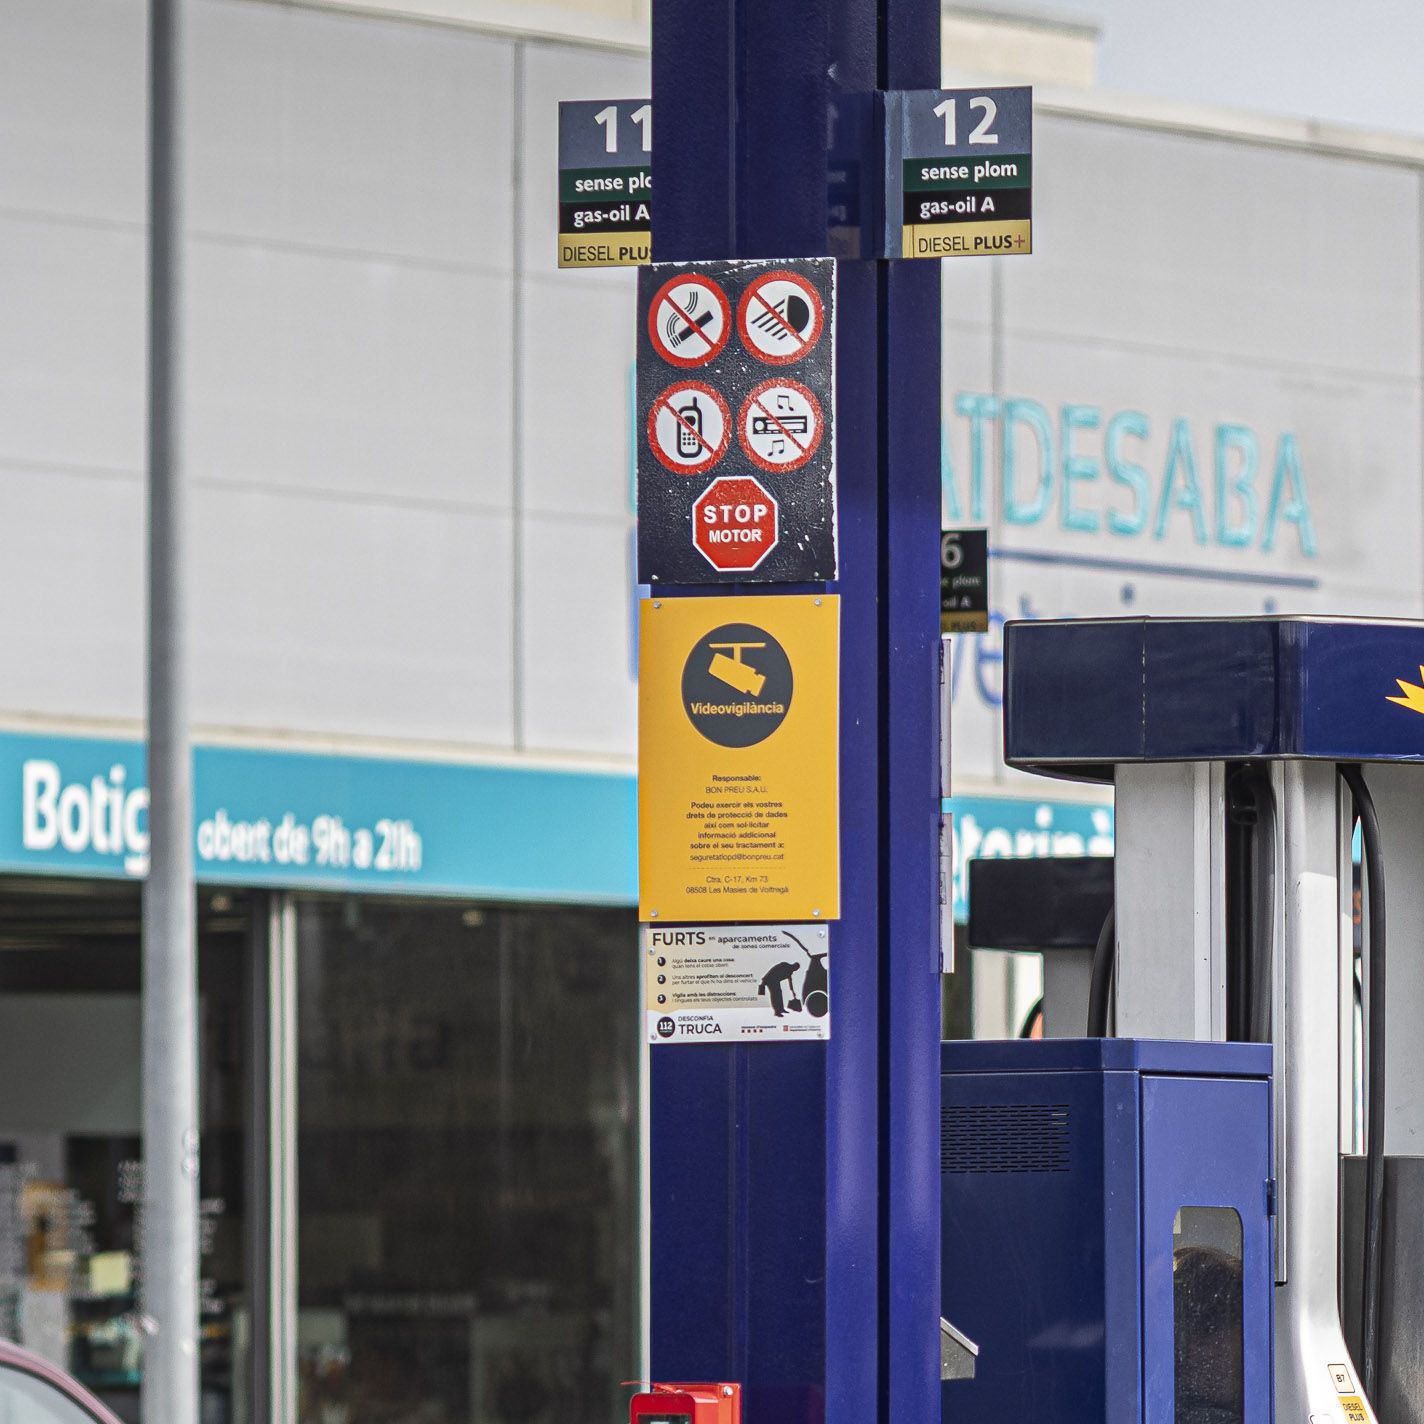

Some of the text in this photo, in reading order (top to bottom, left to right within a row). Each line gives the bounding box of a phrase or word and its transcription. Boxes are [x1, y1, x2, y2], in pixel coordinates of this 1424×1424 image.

[933, 96, 998, 145] 12
[594, 105, 652, 153] 11
[921, 161, 1018, 182] sense plom
[575, 177, 623, 192] sense
[920, 196, 995, 219] gas-oil A
[574, 204, 650, 228] gas-oil A
[918, 237, 969, 253] DIESEL
[563, 246, 652, 262] DIESEL PLU
[942, 391, 1319, 558] TDESABA
[703, 504, 768, 524] STOP
[708, 529, 762, 543] MOTOR
[690, 702, 784, 717] Videovigilància
[705, 786, 722, 794] BON
[22, 758, 150, 877] Botig
[652, 931, 706, 946] FURTS
[718, 935, 778, 944] aparcaments
[659, 1022, 722, 1035] 112 TRUCA
[1342, 1403, 1363, 1411] DIESEL
[1349, 1413, 1365, 1421] PLUS
